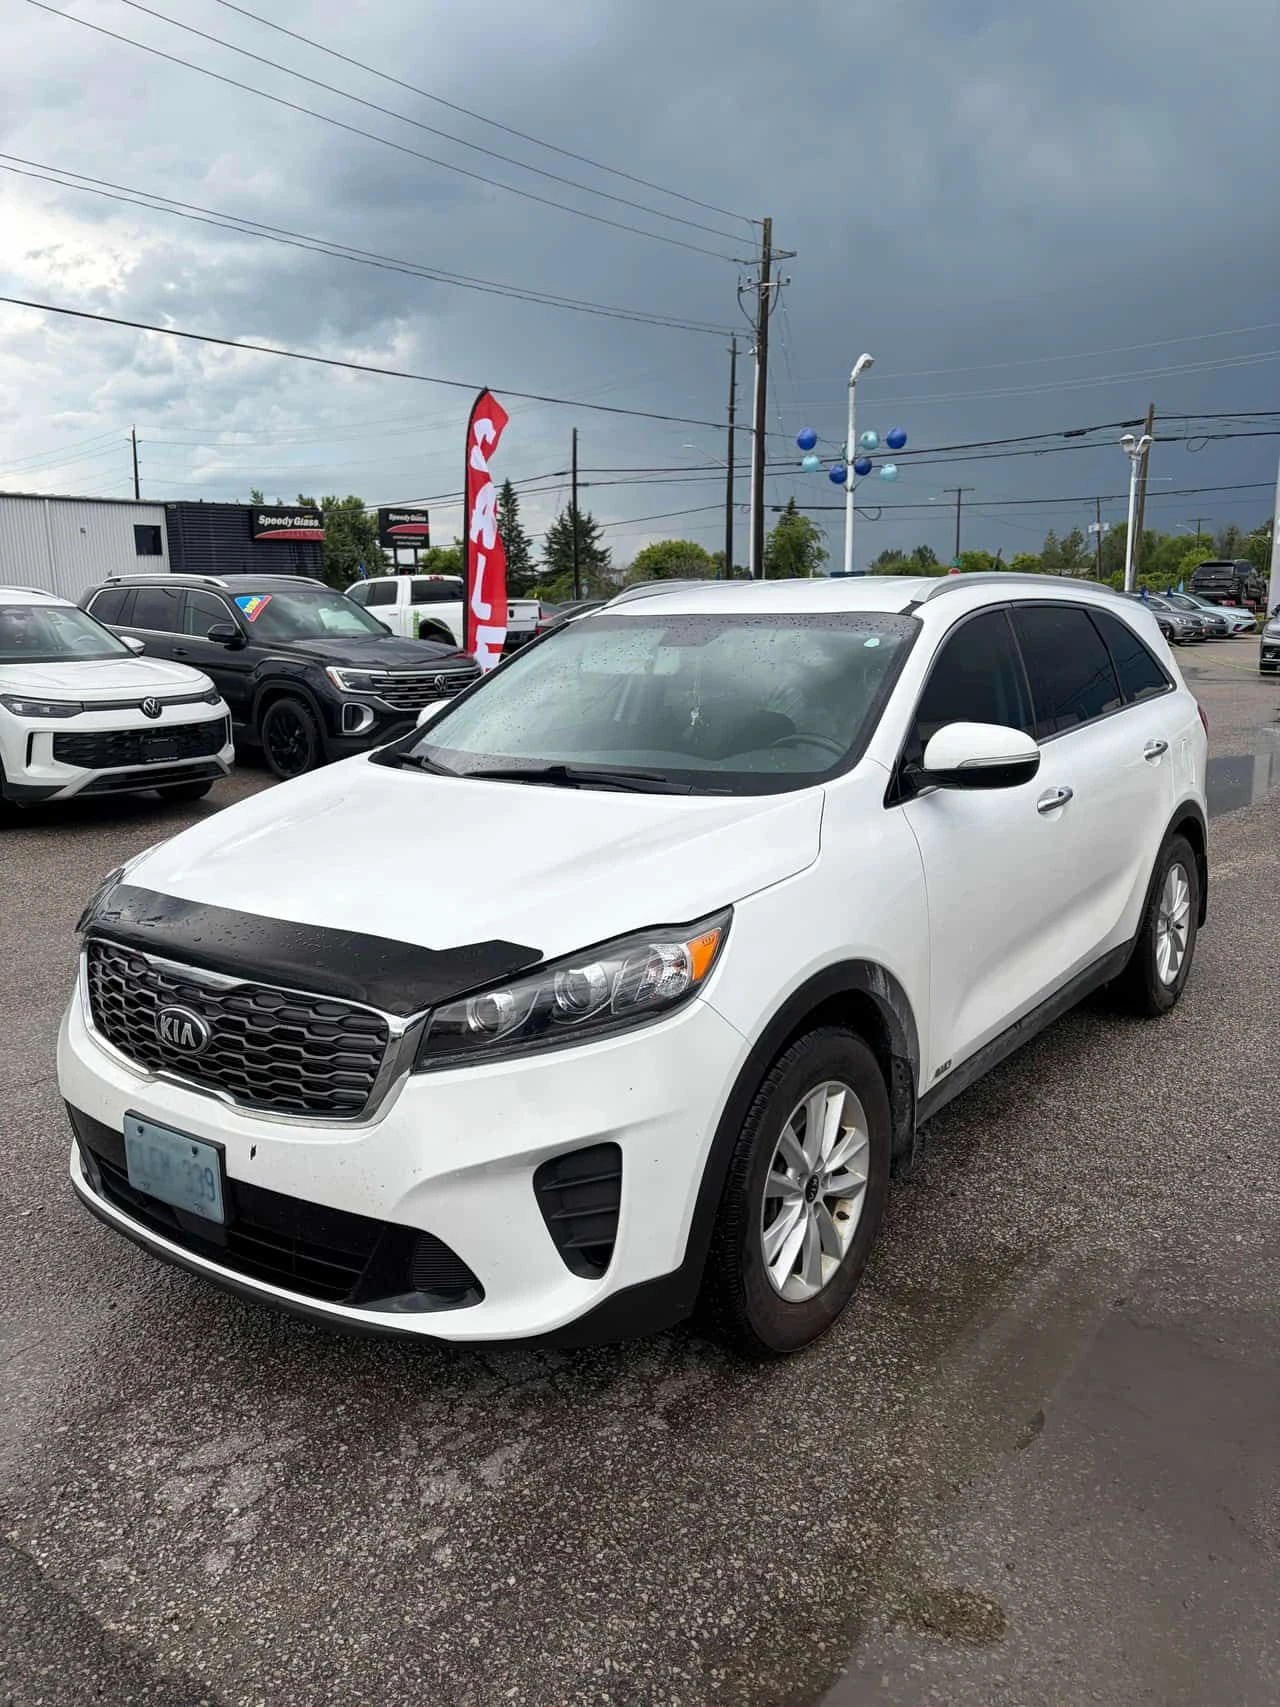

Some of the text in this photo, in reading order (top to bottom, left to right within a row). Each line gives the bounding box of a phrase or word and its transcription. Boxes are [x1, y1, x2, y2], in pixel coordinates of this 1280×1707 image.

[258, 515, 319, 527] Speedy Glass
[470, 418, 507, 672] SALE
[161, 1015, 196, 1047] KIA
